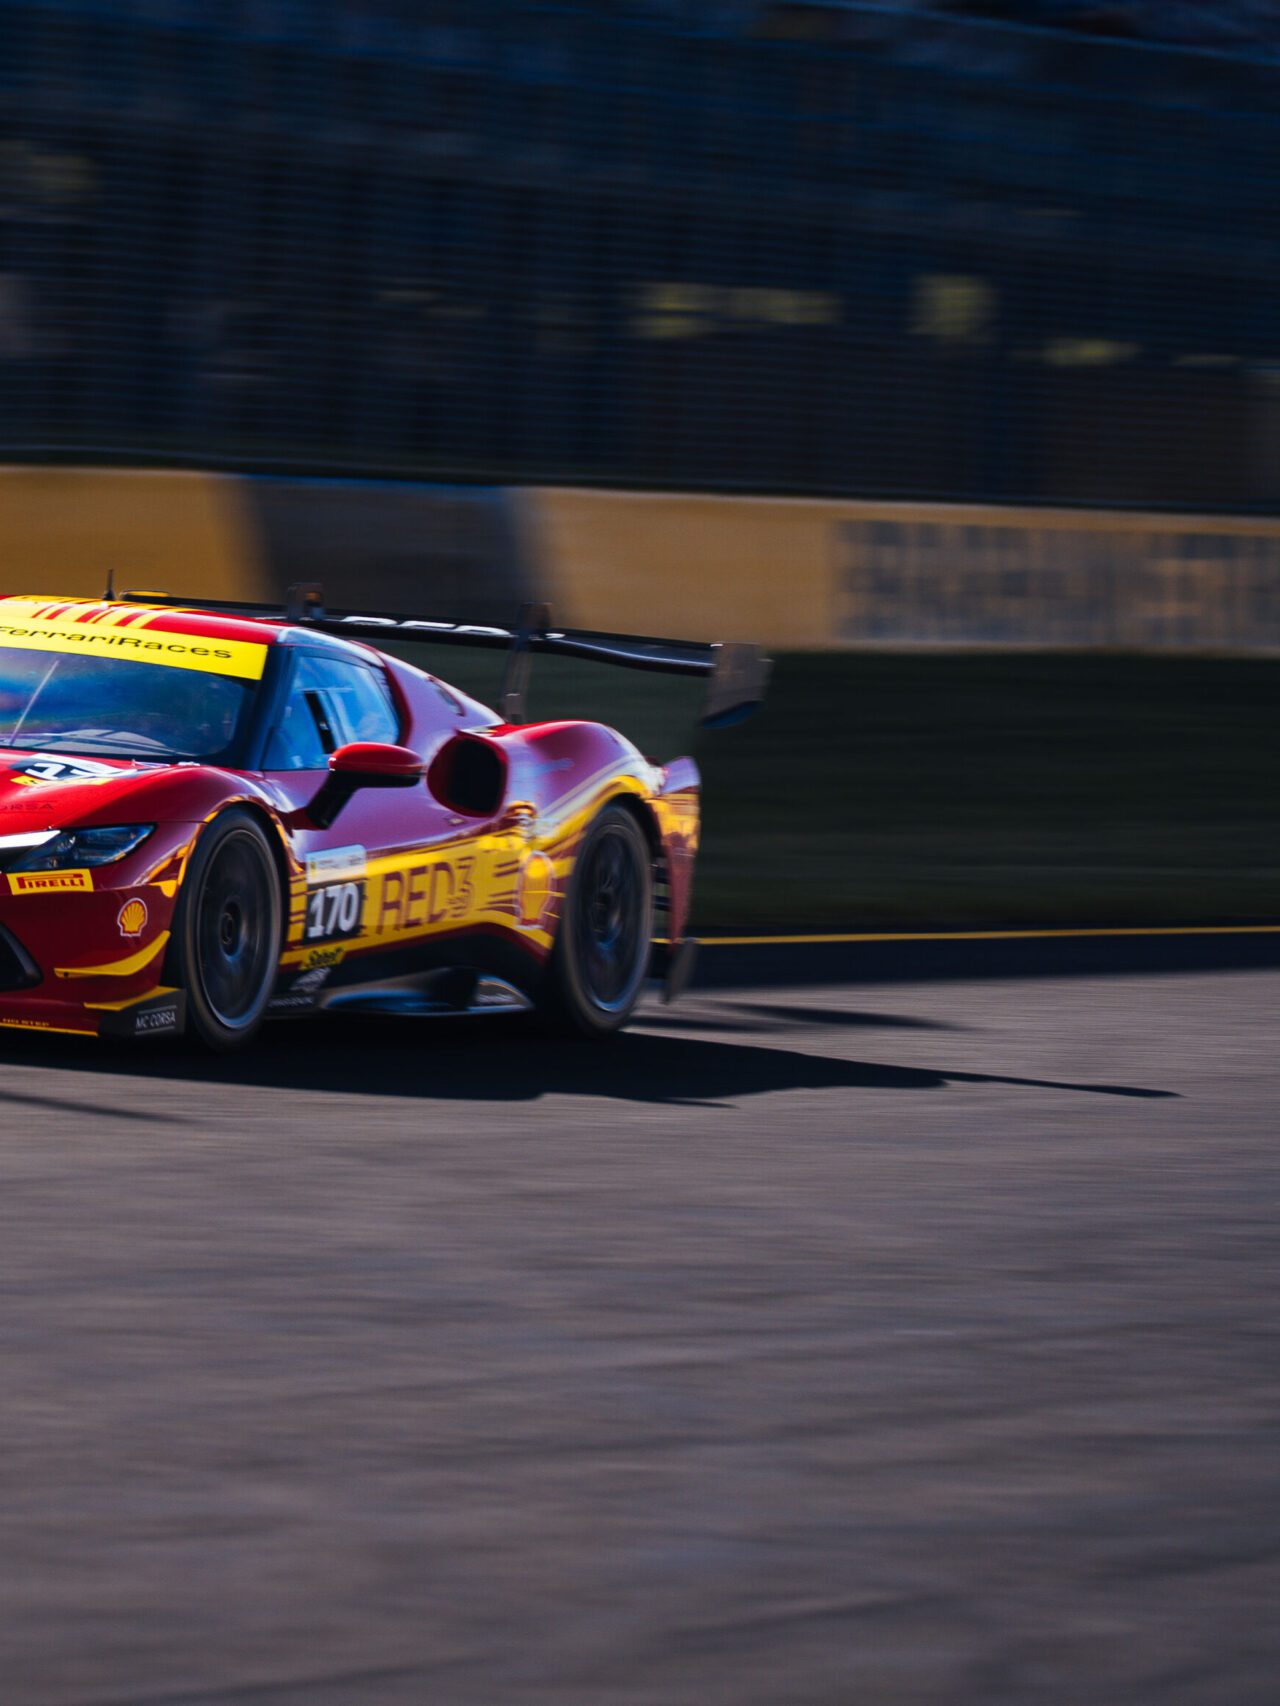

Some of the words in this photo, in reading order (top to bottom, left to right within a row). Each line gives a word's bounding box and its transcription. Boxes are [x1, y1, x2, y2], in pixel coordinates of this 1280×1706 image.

[16, 873, 85, 889] PIRELLI
[307, 882, 360, 938] 170
[135, 1014, 149, 1029] MC
[149, 1010, 176, 1027] CORSA
